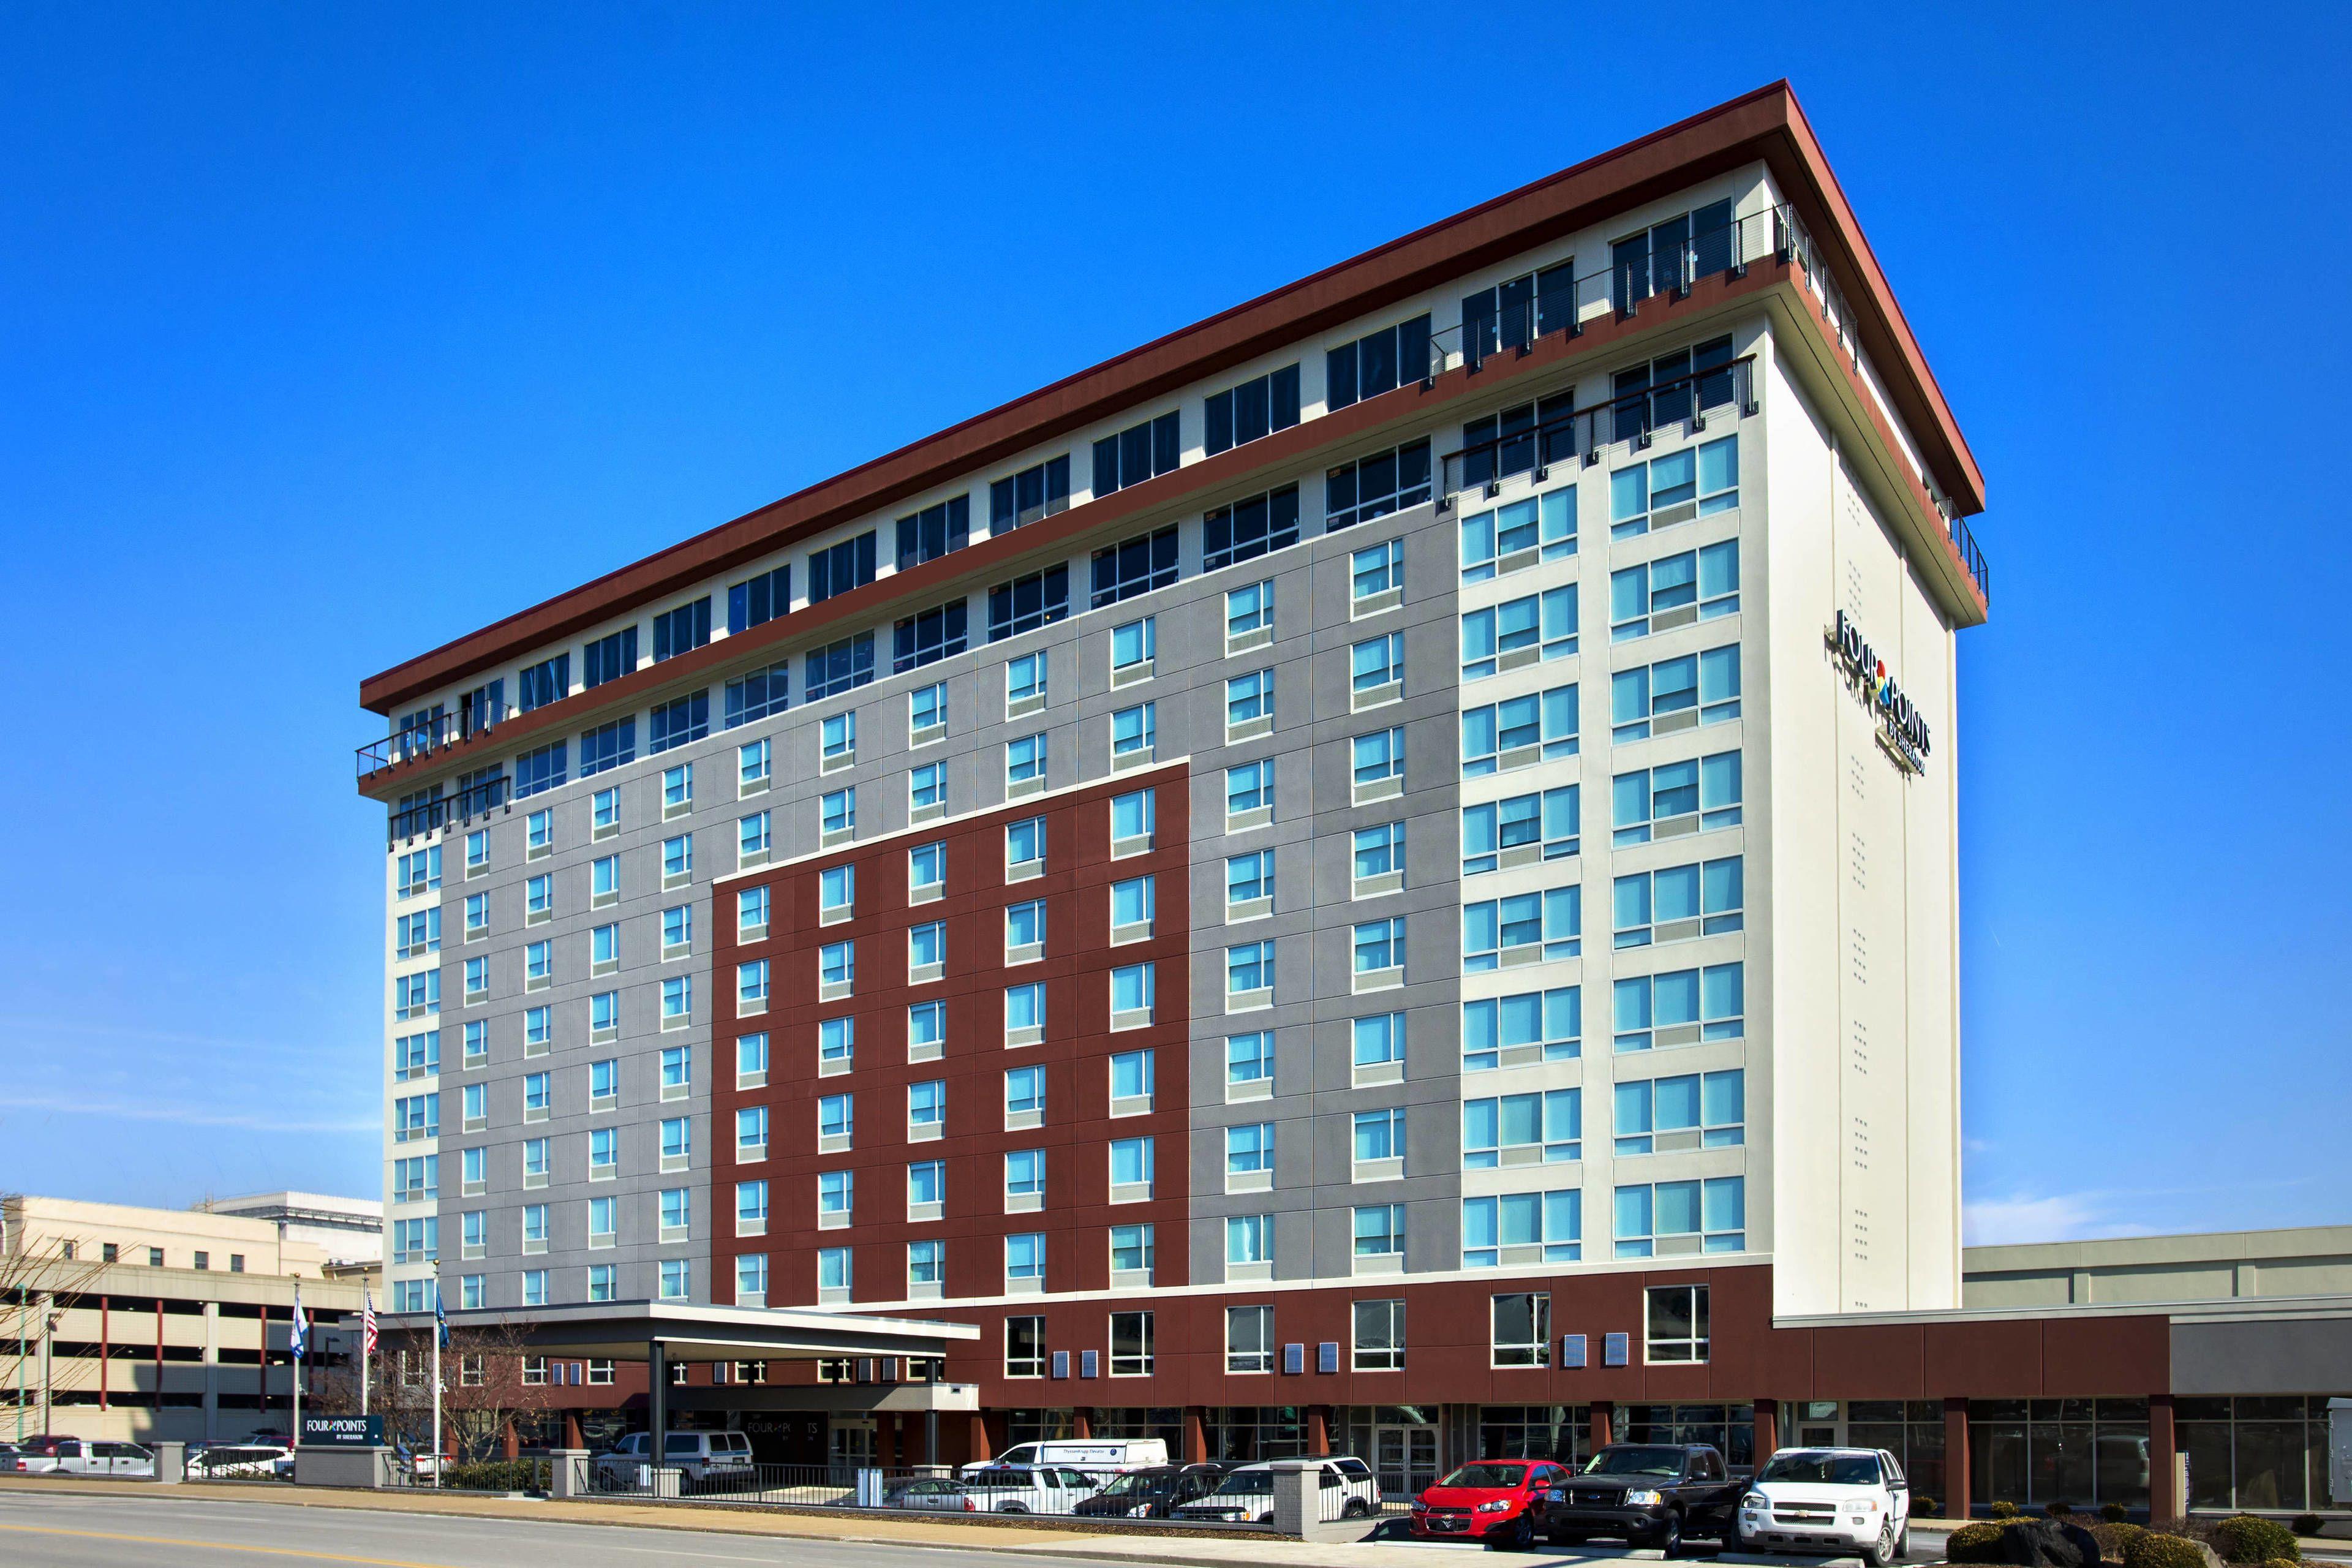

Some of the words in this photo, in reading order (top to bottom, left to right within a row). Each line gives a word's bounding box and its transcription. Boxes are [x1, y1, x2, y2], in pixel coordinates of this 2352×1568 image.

[1837, 609, 1879, 690] FOUR
[1887, 676, 1931, 757] POINTS
[1887, 720, 1897, 739] BY
[1896, 731, 1926, 777] SHERATON
[307, 1420, 329, 1431] FOUR
[337, 1420, 367, 1432] POINTS
[748, 1422, 773, 1433] FOUR
